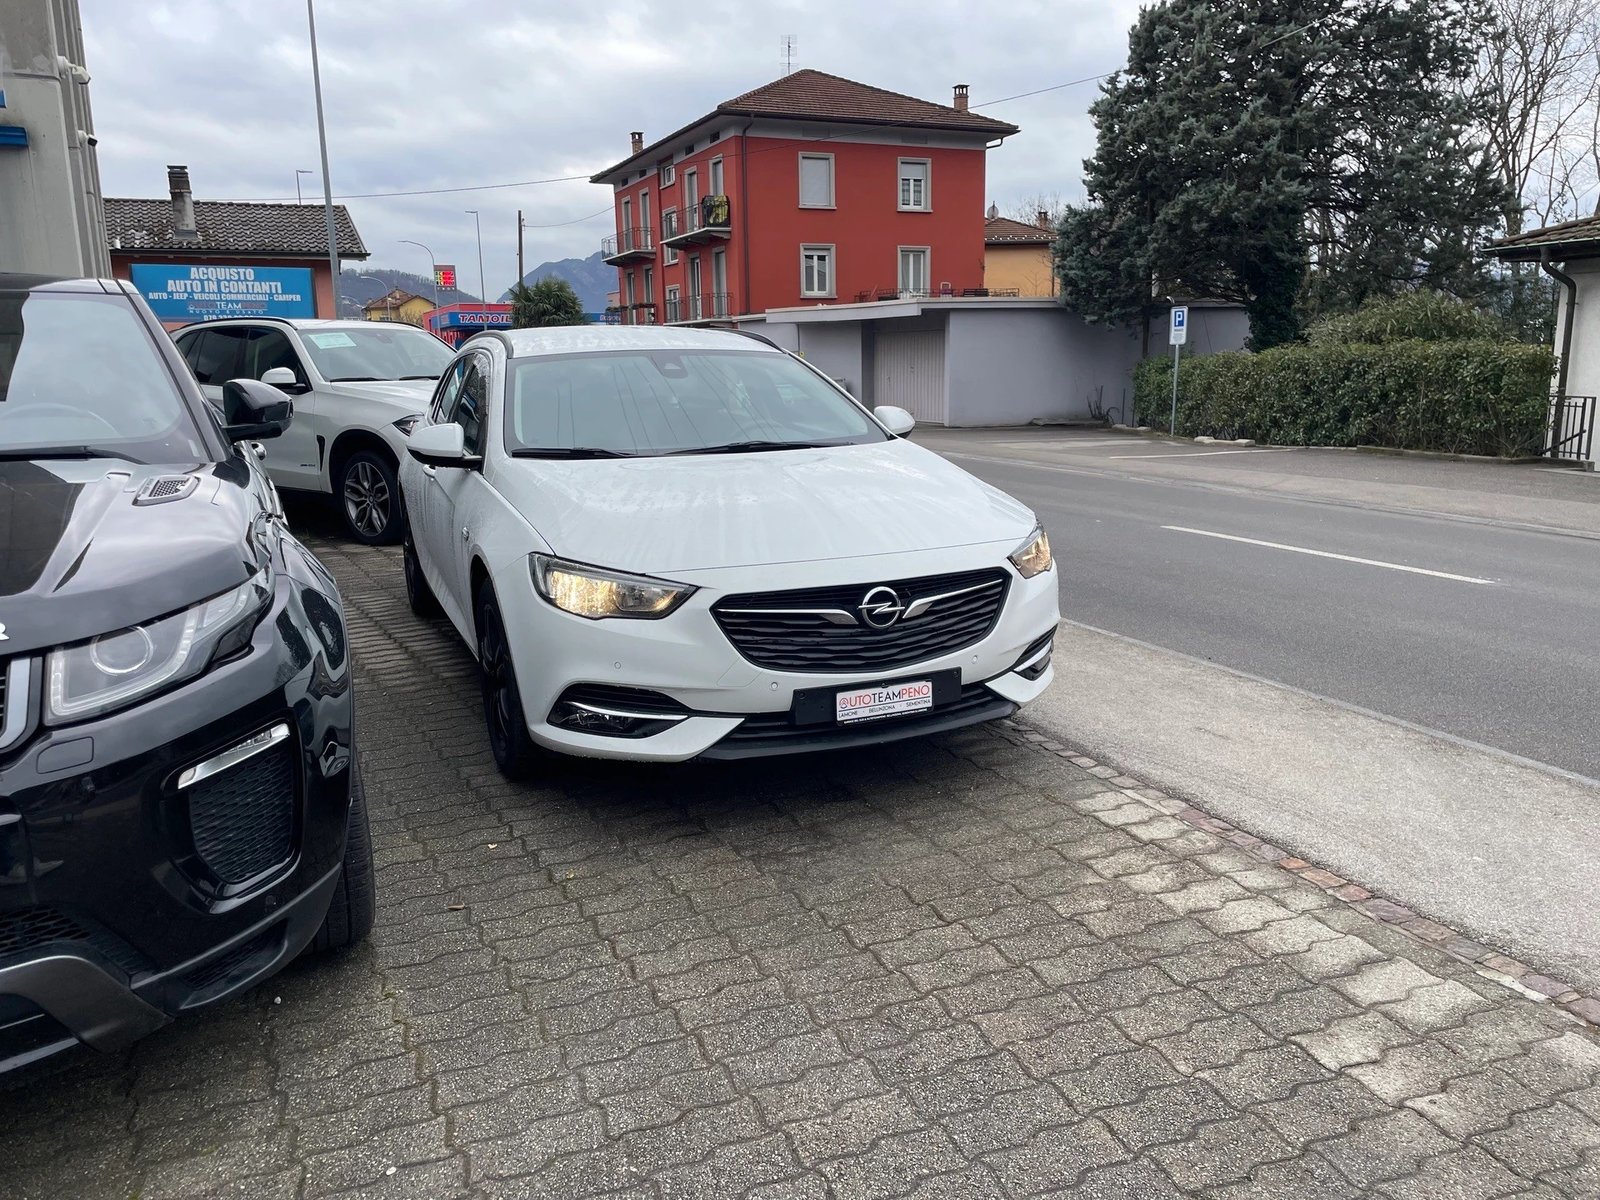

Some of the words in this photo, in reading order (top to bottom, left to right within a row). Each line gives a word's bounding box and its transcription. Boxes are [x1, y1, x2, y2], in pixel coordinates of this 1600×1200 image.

[190, 267, 255, 281] ACQUISTO
[167, 280, 203, 292] AUTO
[204, 281, 219, 293] IN
[220, 281, 282, 293] CONTANTI
[148, 292, 168, 300] AUTO
[193, 293, 221, 301] VEICOLI
[221, 293, 269, 301] COMMERCIALI
[273, 294, 301, 302] CAMPER
[458, 313, 513, 324] TAMOIL
[1175, 311, 1183, 326] P
